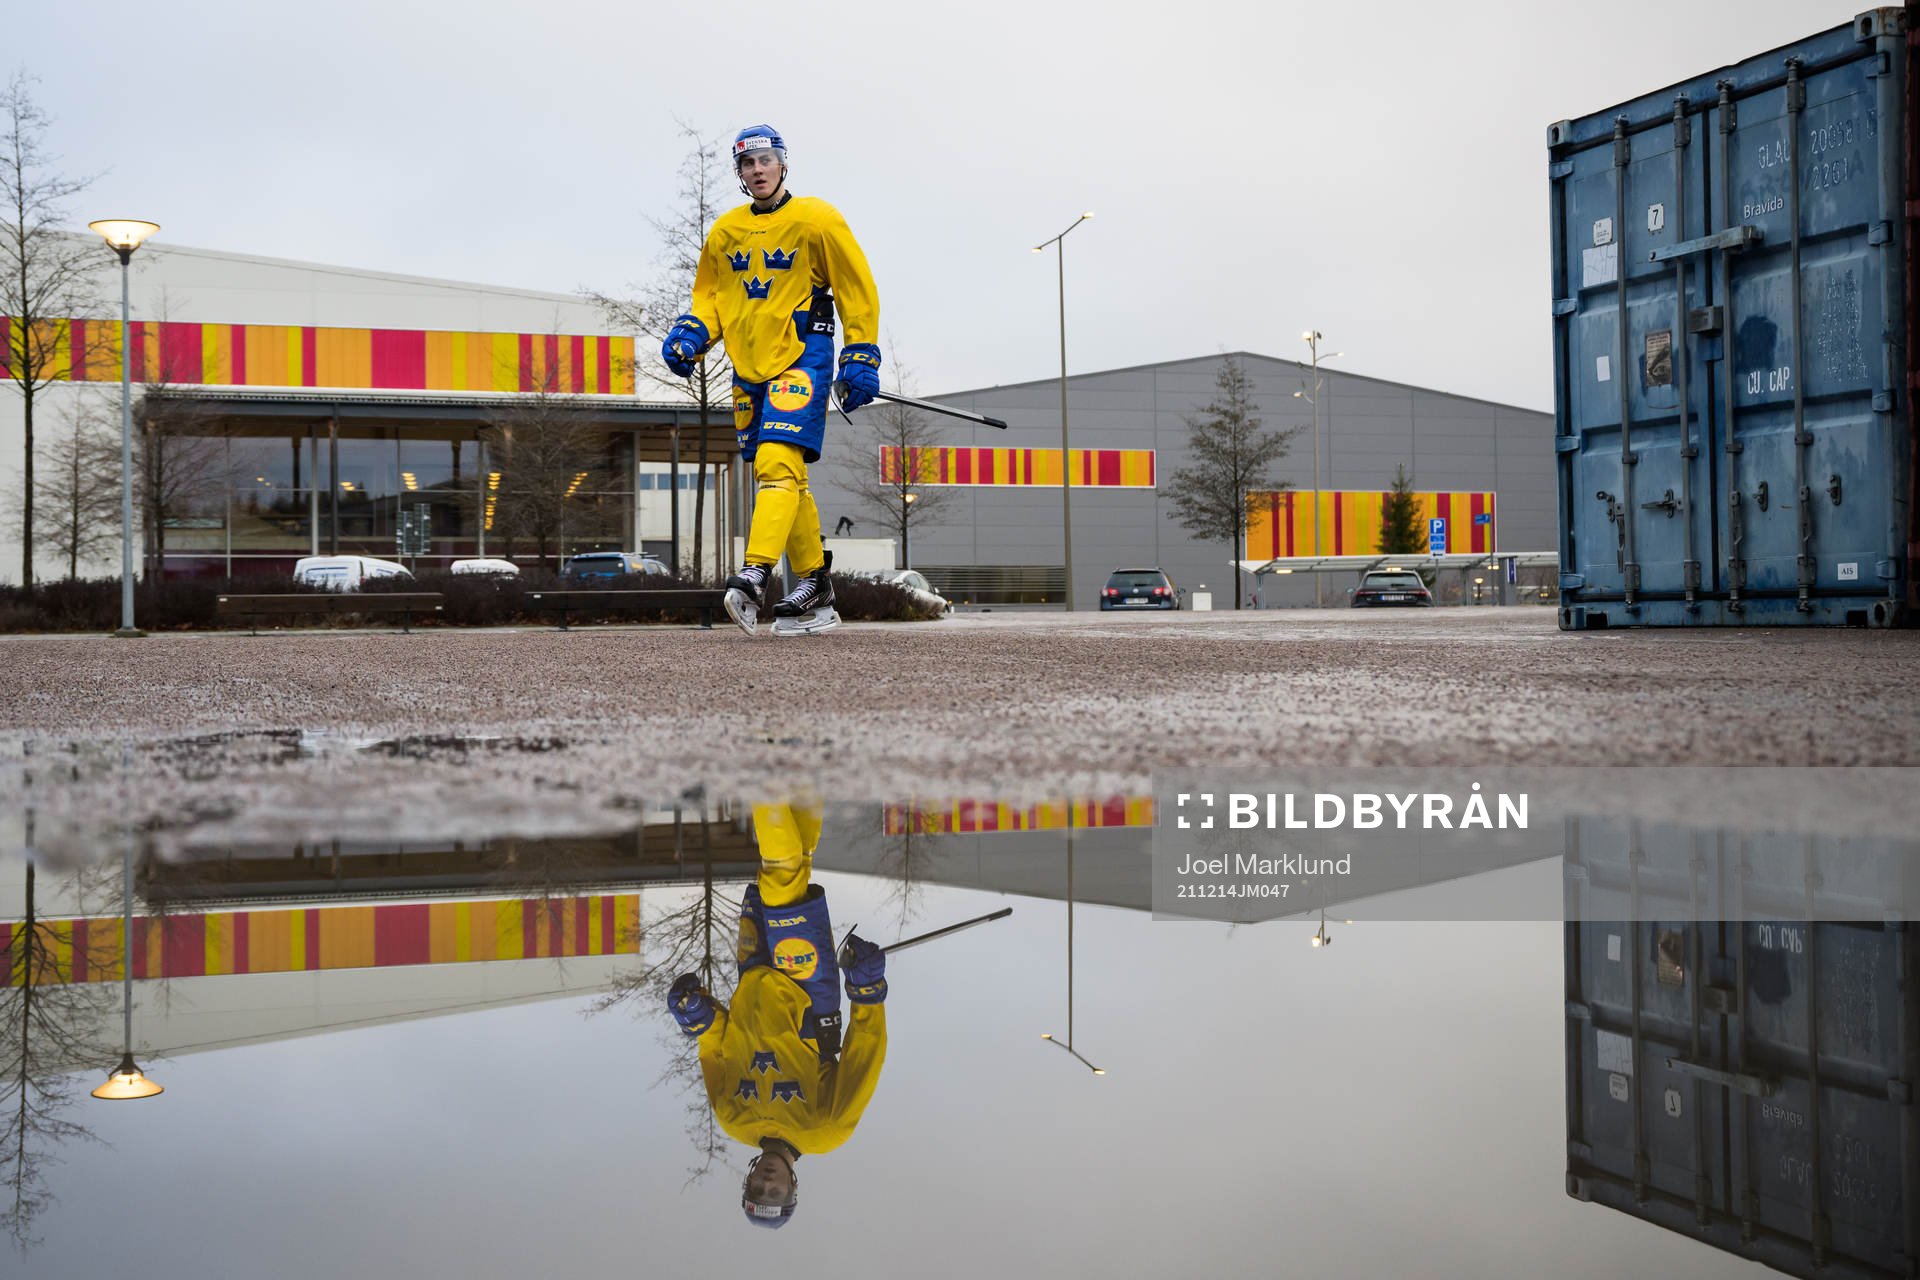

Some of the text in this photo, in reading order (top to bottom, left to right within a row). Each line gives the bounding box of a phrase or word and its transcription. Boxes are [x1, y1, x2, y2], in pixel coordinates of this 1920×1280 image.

[1743, 196, 1784, 218] Bravida
[1652, 208, 1659, 226] 7
[839, 352, 879, 368] CCM
[1747, 366, 1794, 394] CU. CAP.
[763, 421, 803, 433] CCM
[1433, 519, 1442, 533] P
